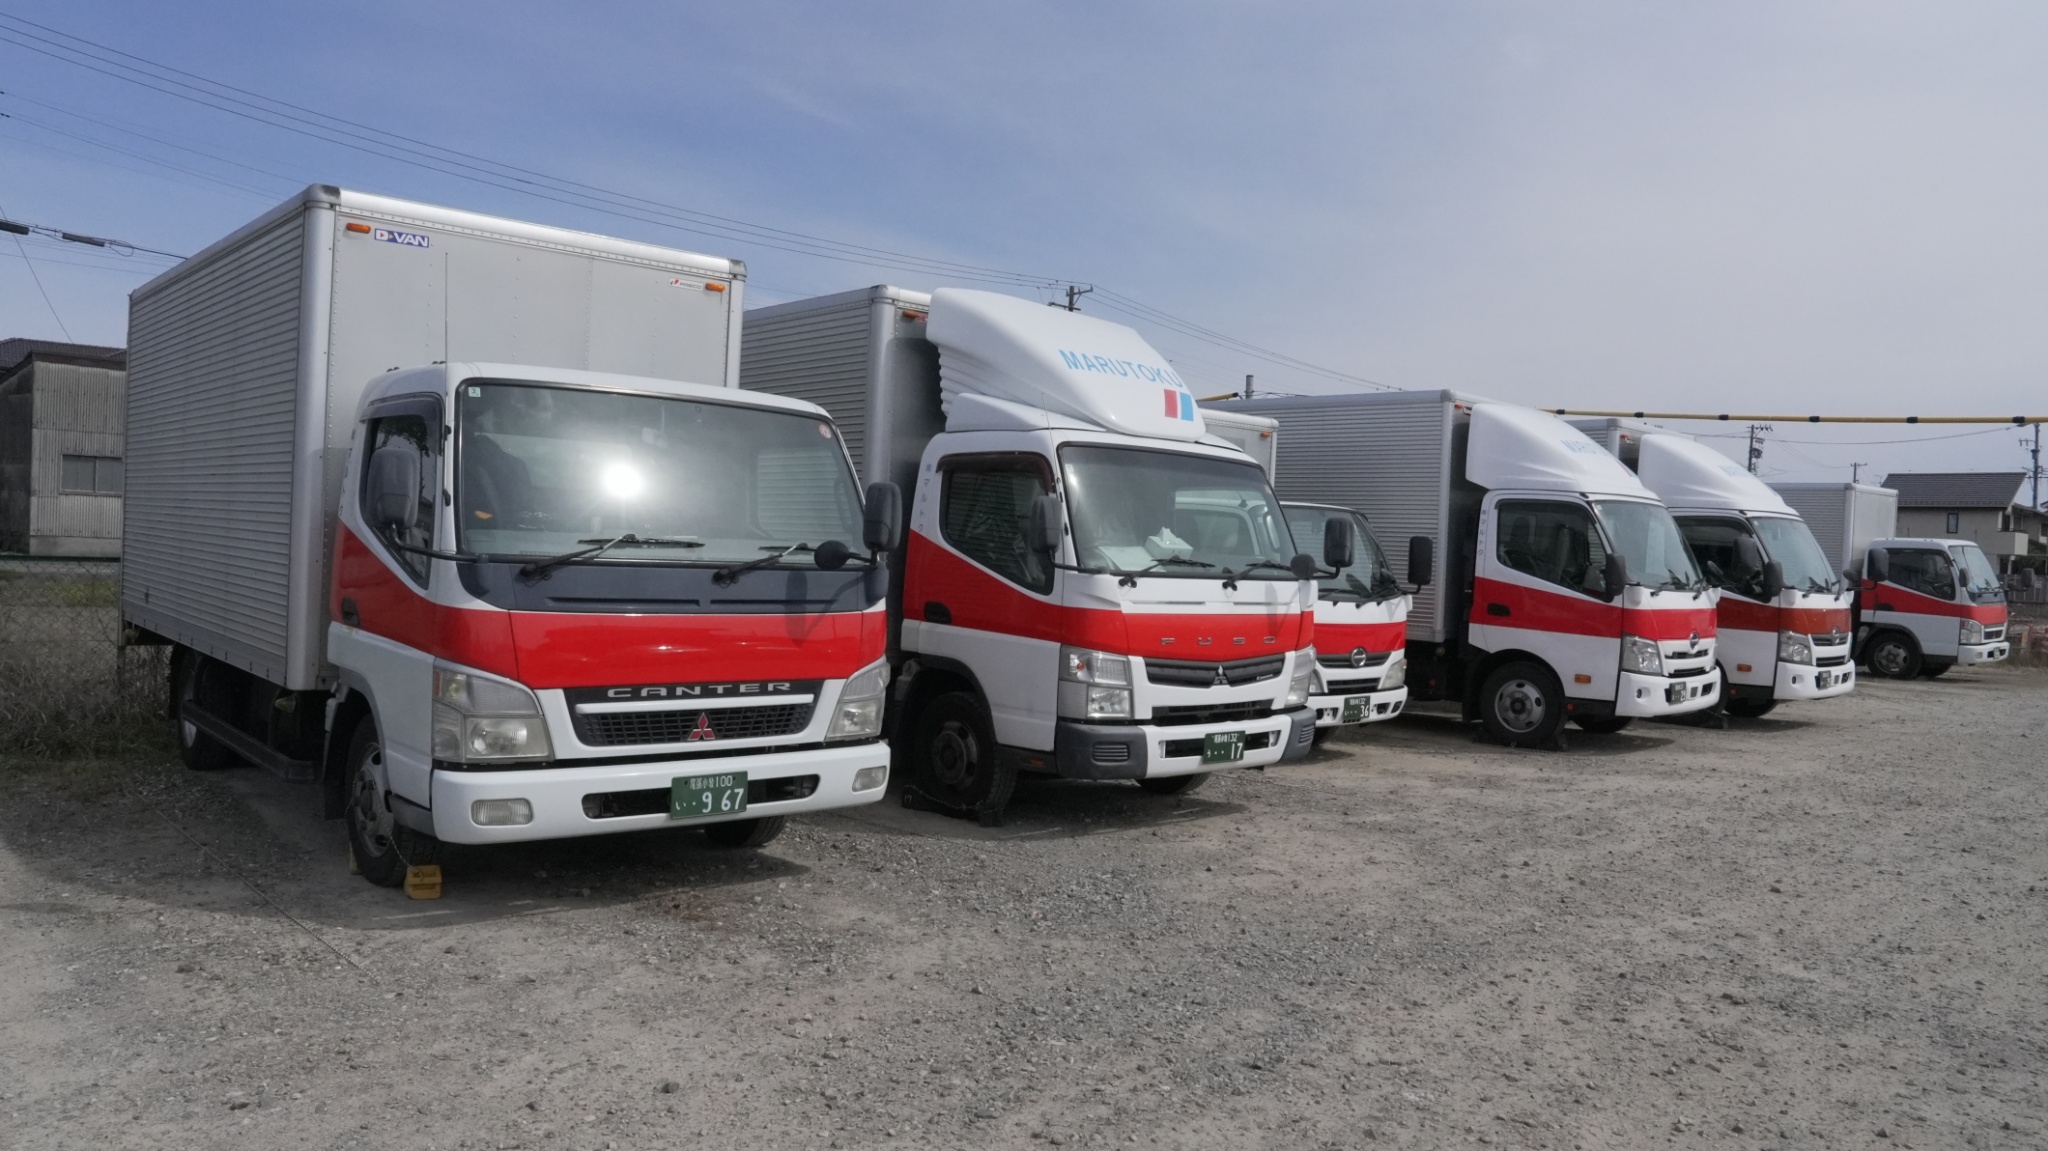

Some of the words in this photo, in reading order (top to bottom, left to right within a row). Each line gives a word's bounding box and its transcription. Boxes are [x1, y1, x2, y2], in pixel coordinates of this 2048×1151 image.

[1058, 349, 1184, 389] MARUTOKU
[1161, 636, 1277, 646] FUSO
[607, 682, 791, 698] CANTER
[1360, 704, 1369, 717] 36
